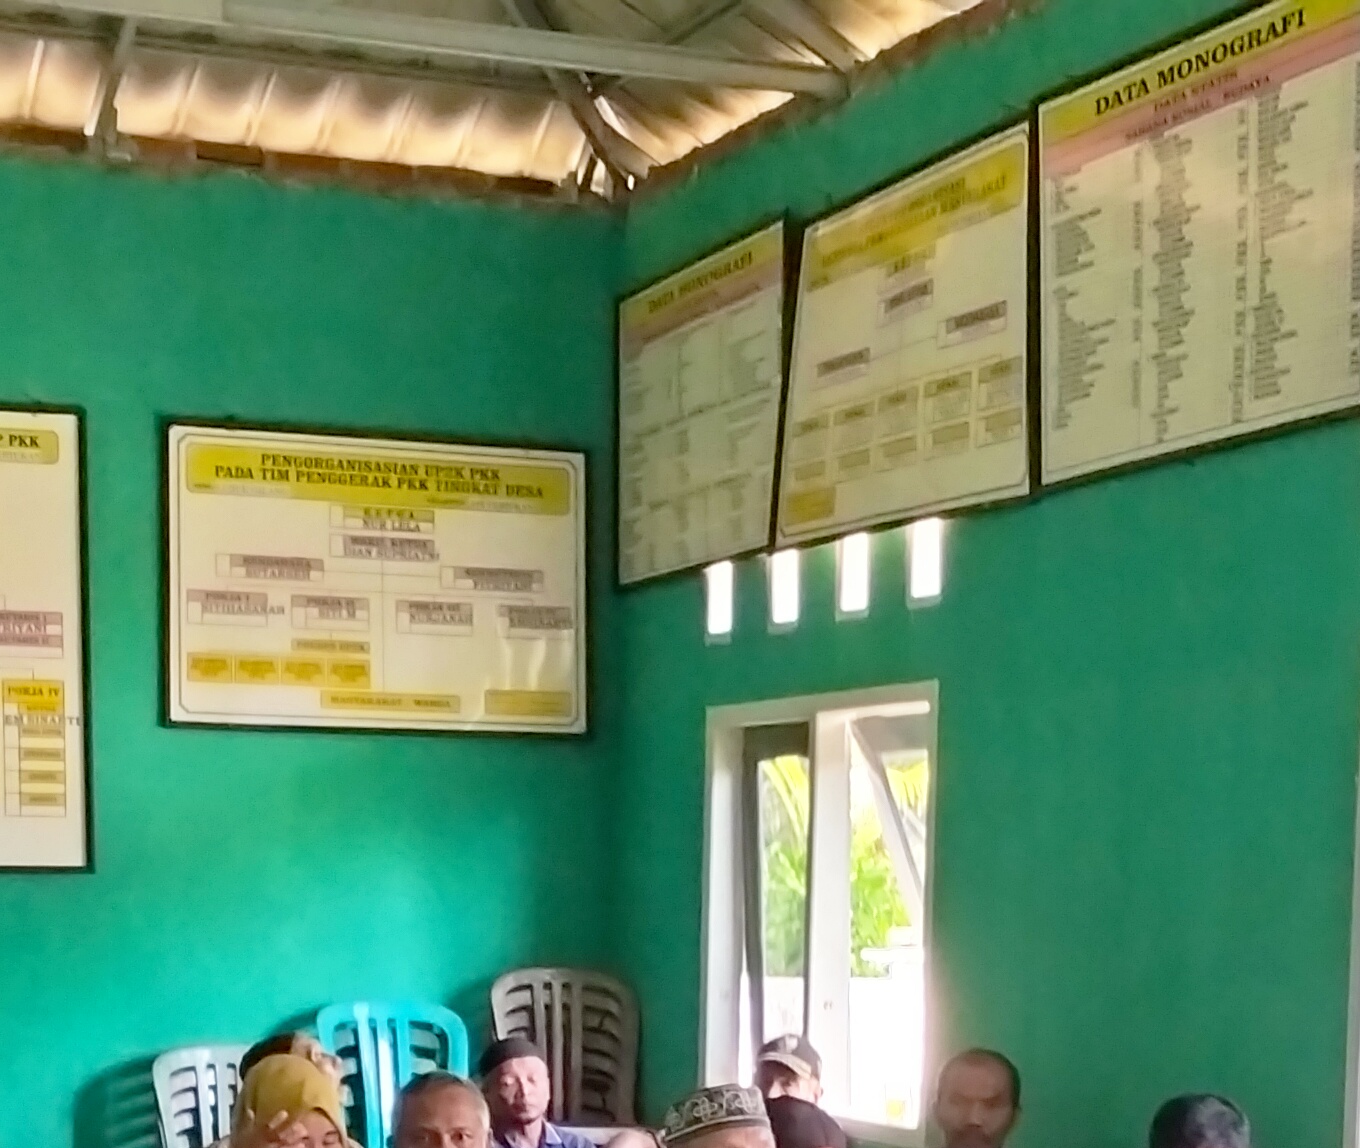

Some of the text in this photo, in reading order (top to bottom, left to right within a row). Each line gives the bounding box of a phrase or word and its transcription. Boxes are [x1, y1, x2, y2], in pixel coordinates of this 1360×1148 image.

[1094, 8, 1306, 116] DATA MONOGRAFI
[9, 435, 41, 448] PKK
[215, 465, 254, 479] PADA
[261, 468, 290, 482] TIM
[296, 470, 392, 489] PENGGERAK
[397, 477, 429, 491] PKK
[436, 479, 499, 496] TINGKAT
[505, 484, 544, 498] DESA
[261, 453, 419, 476] PENGORGANISASIAN
[470, 468, 501, 481] PKK
